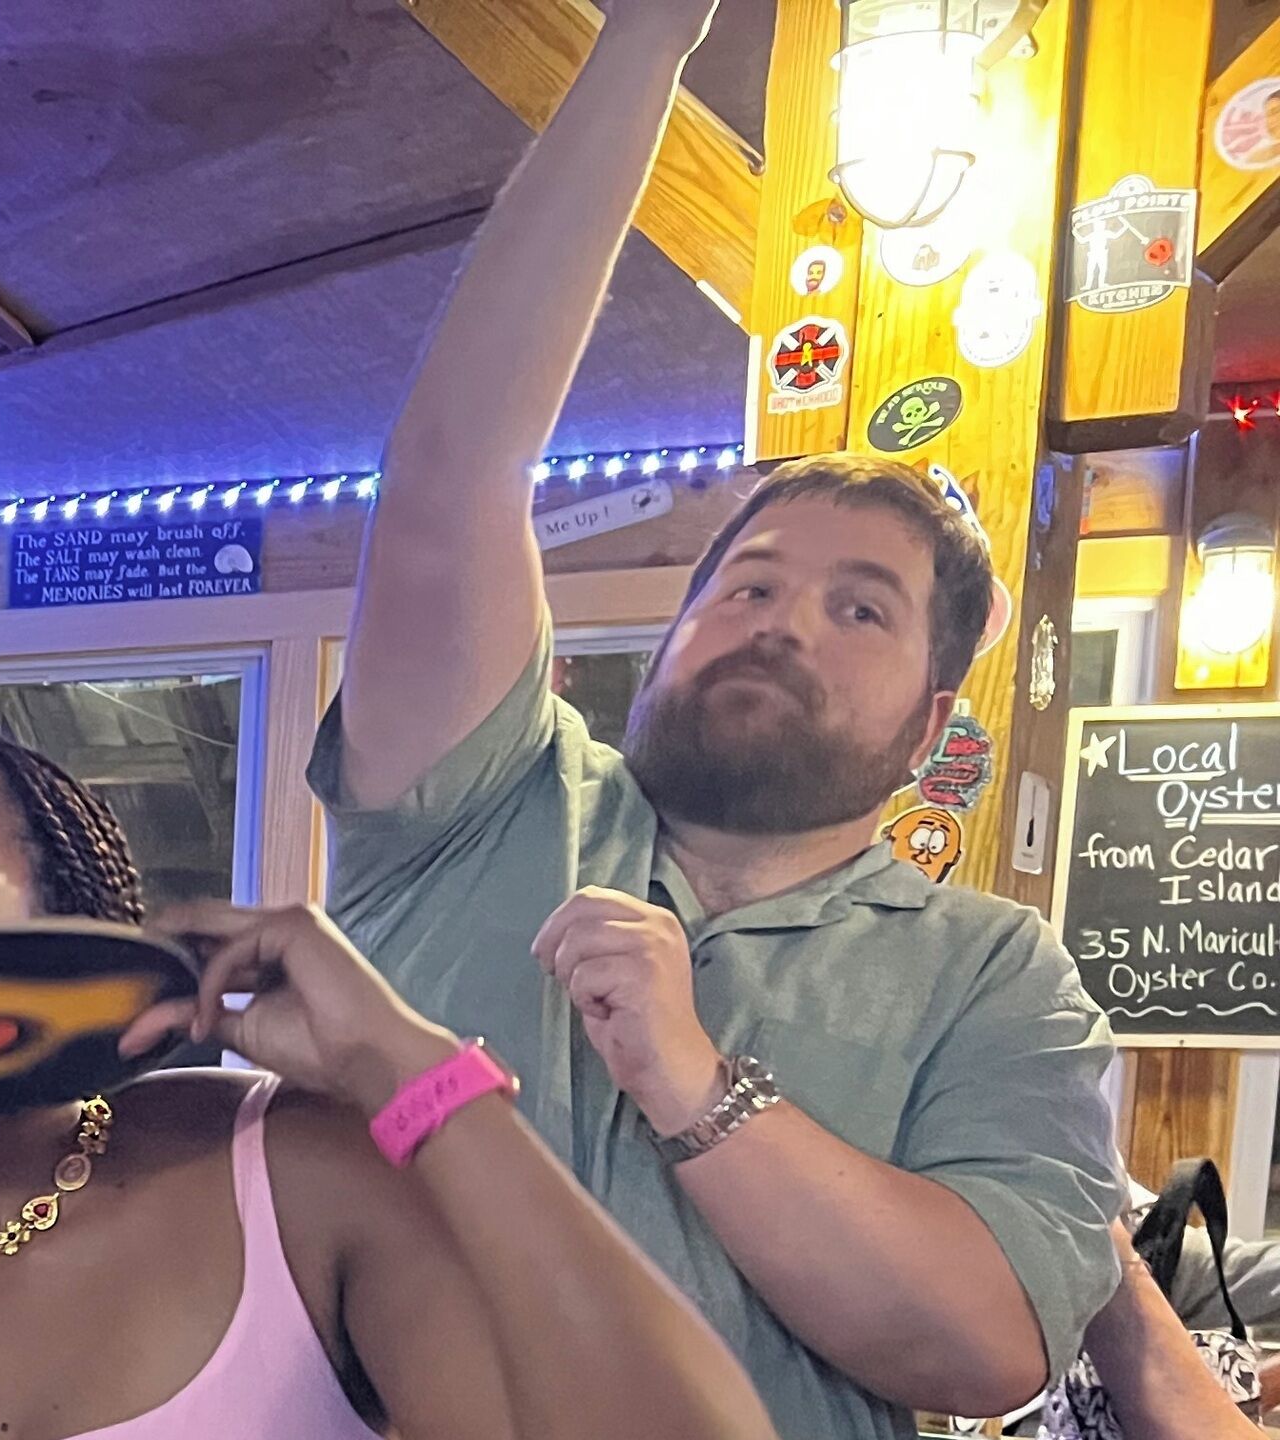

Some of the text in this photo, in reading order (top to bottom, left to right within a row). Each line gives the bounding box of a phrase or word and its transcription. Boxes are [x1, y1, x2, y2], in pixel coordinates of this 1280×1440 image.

[1088, 285, 1163, 305] KITCHEN
[15, 533, 47, 550] The
[53, 530, 104, 548] SAND
[110, 531, 149, 547] may
[156, 523, 204, 542] brush
[545, 520, 571, 537] Me
[575, 507, 599, 528] Up
[15, 550, 40, 568] The
[45, 547, 82, 566] SALT
[88, 550, 123, 566] may
[125, 546, 161, 561] wash
[15, 567, 39, 585] The
[44, 565, 81, 583] TANS
[85, 567, 115, 584] may
[158, 562, 180, 577] But
[186, 561, 208, 576] the
[41, 576, 253, 604] MEMORIES will last FOREVER
[1118, 722, 1238, 776] Local
[1078, 832, 1279, 871] from Cedar
[1079, 919, 1280, 960] 35 N. Maricul
[1108, 961, 1277, 1003] Oyster Co.
